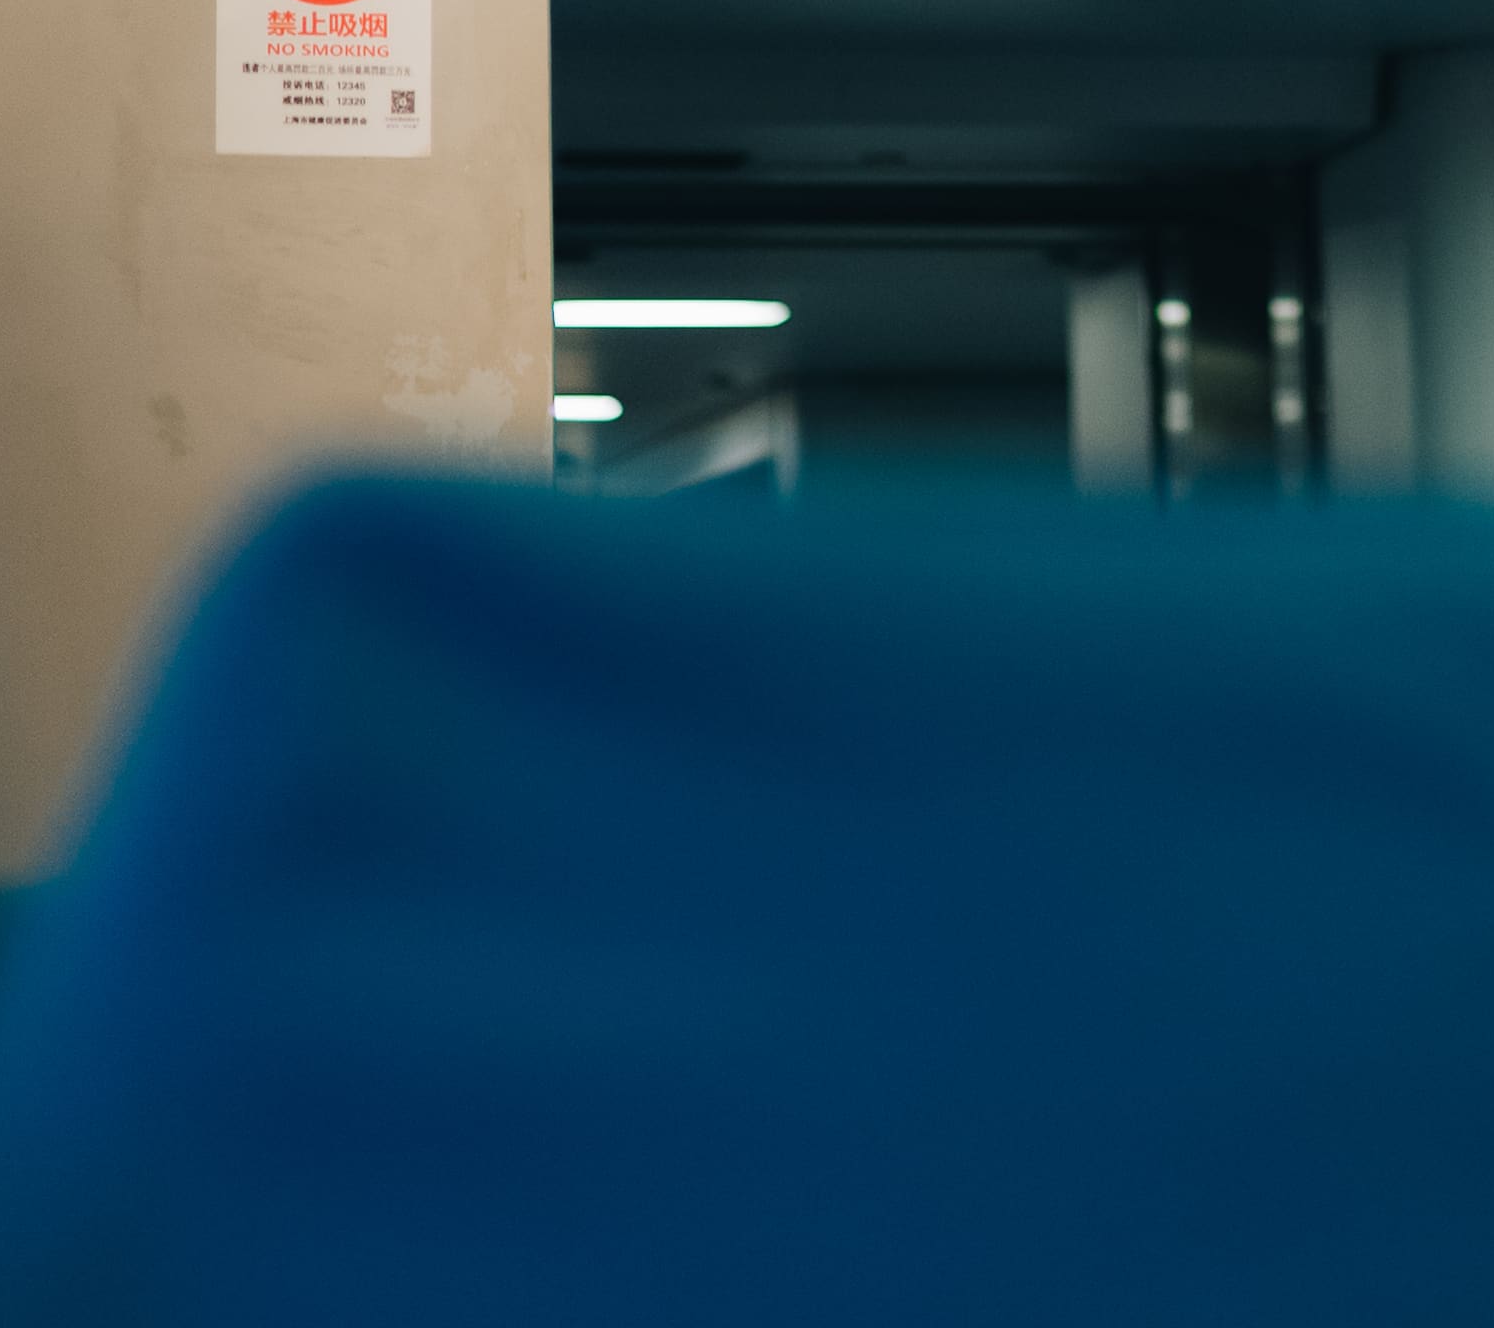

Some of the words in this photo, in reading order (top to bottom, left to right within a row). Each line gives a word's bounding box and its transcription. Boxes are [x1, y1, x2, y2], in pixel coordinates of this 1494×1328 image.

[267, 10, 388, 38] 禁止吸烟
[267, 43, 295, 55] NO
[301, 44, 390, 58] SMOKING
[337, 81, 366, 91] 12345
[337, 97, 366, 107] 12320
